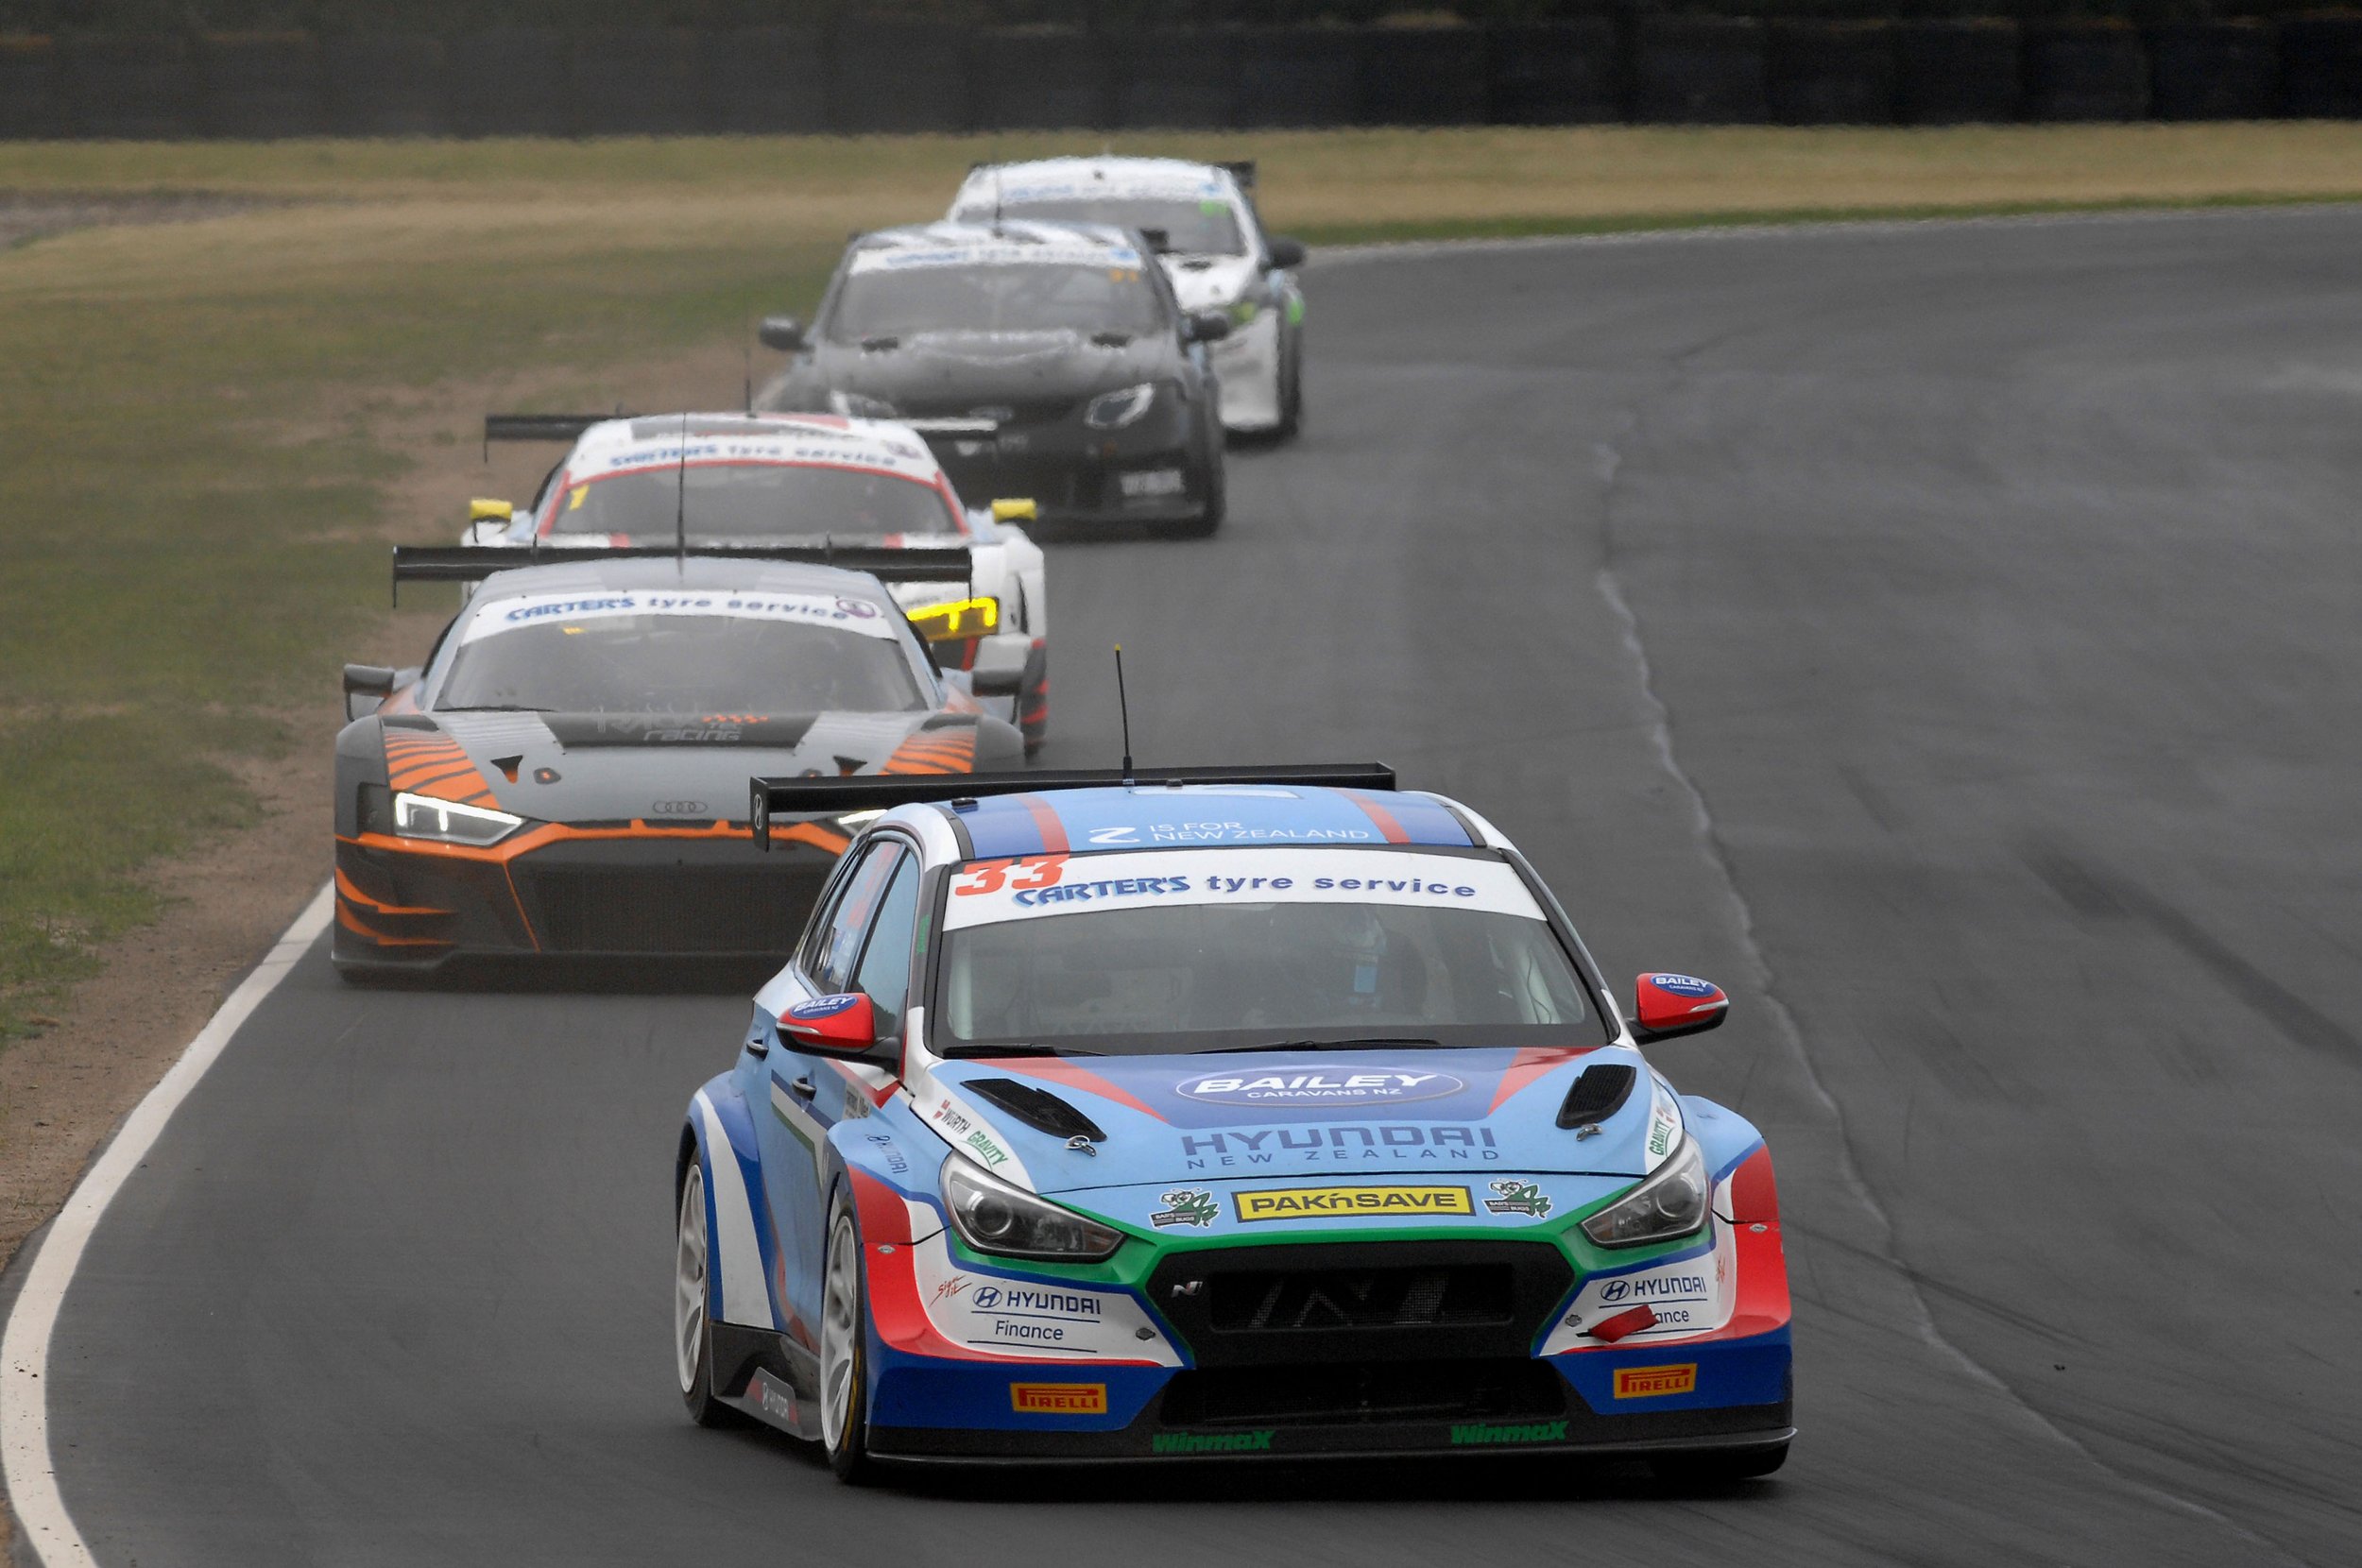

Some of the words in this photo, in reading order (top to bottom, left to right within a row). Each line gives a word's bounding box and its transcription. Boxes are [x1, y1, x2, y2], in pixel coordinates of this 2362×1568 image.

[505, 597, 636, 622] CARTER'S
[648, 597, 712, 607] tyre
[727, 598, 850, 621] service
[1088, 827, 1141, 844] Z
[1150, 824, 1174, 832] IS
[1183, 821, 1244, 831] FOR
[1153, 830, 1224, 842] NEW
[1234, 828, 1370, 840] ZEALAND
[954, 853, 1071, 896] 33
[1013, 875, 1191, 907] CARTER'S
[1206, 875, 1293, 893] tyre
[1314, 878, 1477, 897] service
[1655, 977, 1708, 988] BAILEY
[793, 996, 853, 1013] BAILEY
[1193, 1074, 1437, 1094] BAILEY
[1247, 1088, 1367, 1099] CARAVANS
[1373, 1087, 1404, 1096] NZ
[967, 1131, 1009, 1166] GRAVITY
[1181, 1126, 1497, 1156] HYUNDAI
[1187, 1153, 1274, 1169] NEW
[1305, 1149, 1499, 1161] ZEALAND
[1635, 1276, 1707, 1297] HYUNDAI
[1007, 1290, 1102, 1315] HYUNDAI
[1654, 1309, 1689, 1323] ance
[995, 1320, 1064, 1341] Finance
[1619, 1368, 1691, 1394] PIRELLI
[1017, 1387, 1099, 1409] PIRELLI
